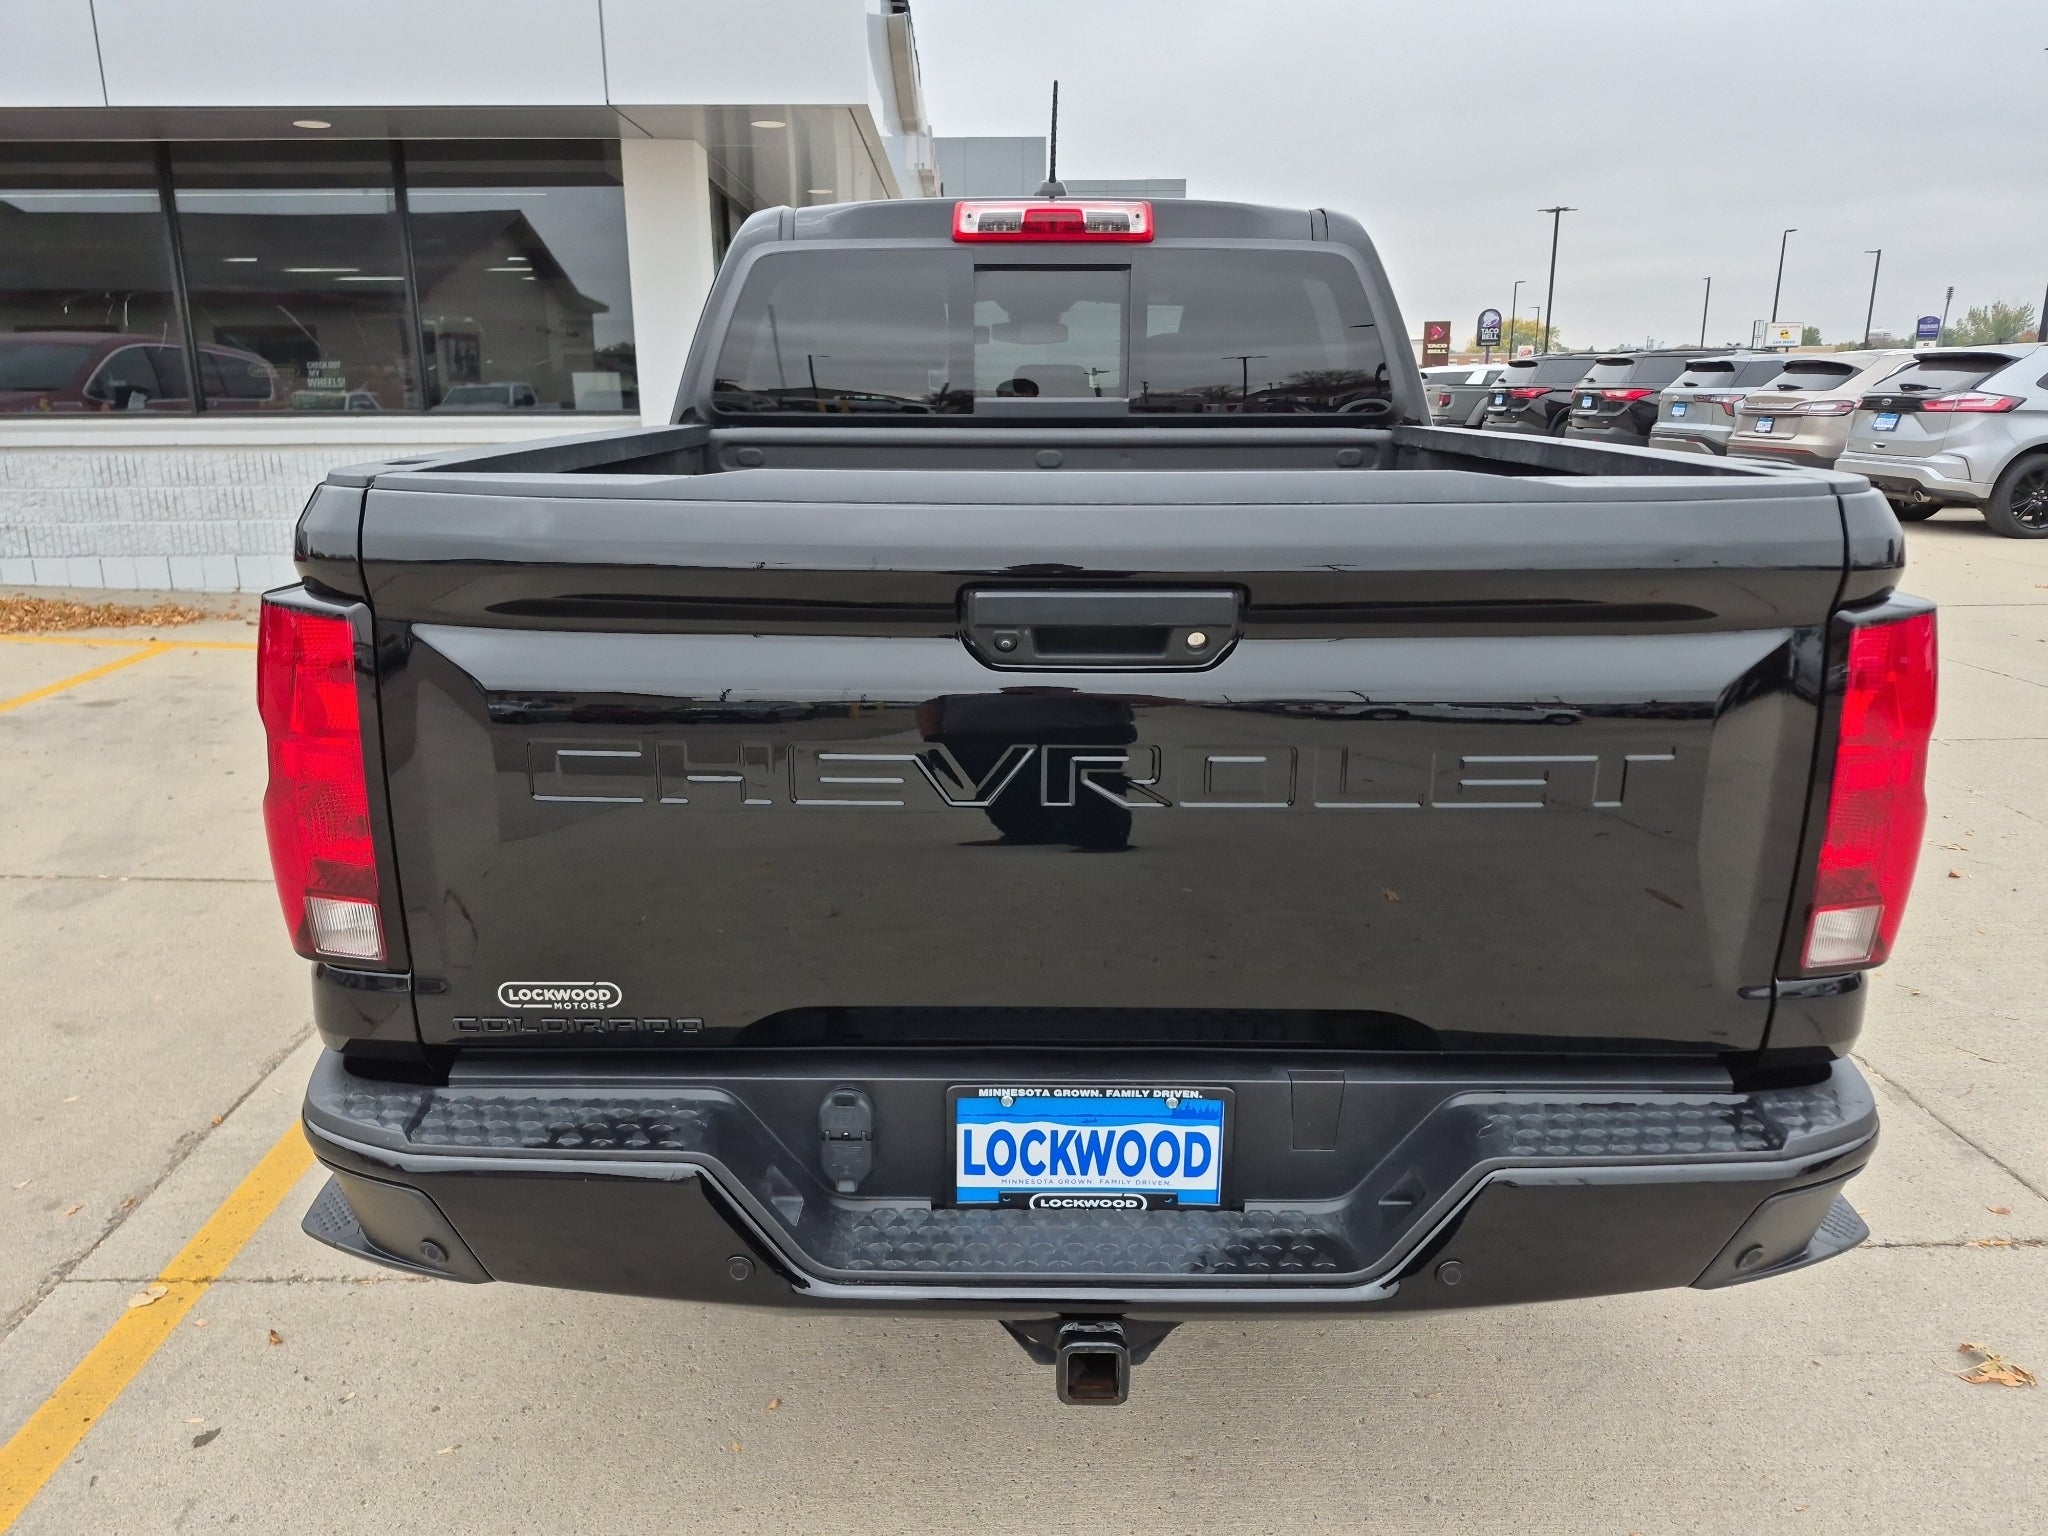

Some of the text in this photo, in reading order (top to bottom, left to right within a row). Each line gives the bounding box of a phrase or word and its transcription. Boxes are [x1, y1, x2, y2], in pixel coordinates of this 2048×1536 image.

[527, 739, 1676, 808] CHEVROLET
[508, 988, 611, 1001] LOCKWOOD
[553, 1002, 605, 1010] MOTORS
[452, 1017, 704, 1034] COLORADO
[978, 1088, 1203, 1099] MINNESOTA GROWN. FAMILY DRIVEN.
[963, 1129, 1212, 1178] LOCKWOOD
[1040, 1198, 1138, 1208] LOCKWOOD
